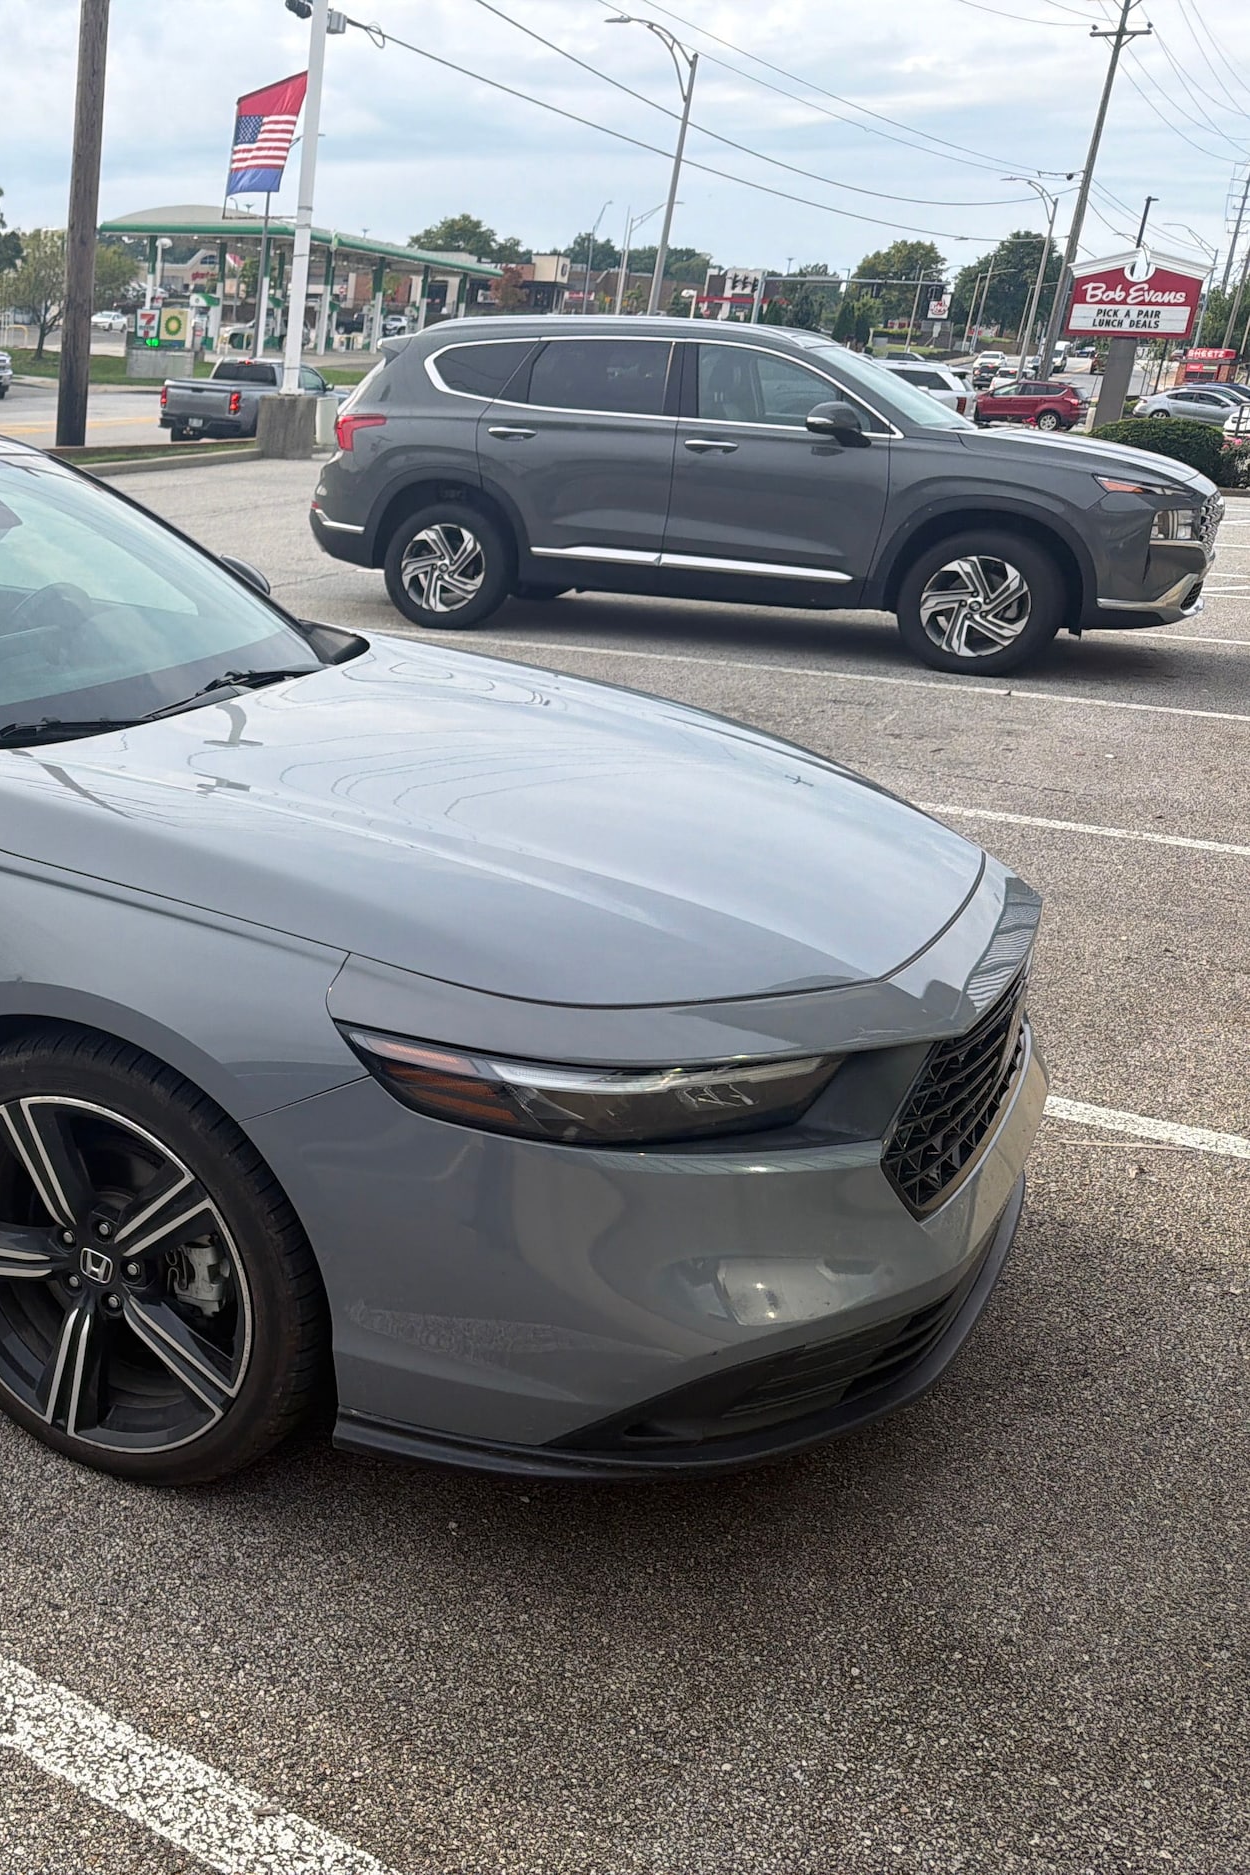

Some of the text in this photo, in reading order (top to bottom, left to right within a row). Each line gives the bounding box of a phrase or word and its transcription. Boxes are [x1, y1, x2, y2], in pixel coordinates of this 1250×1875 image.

[1081, 282, 1186, 304] Bob Evans
[1096, 308, 1161, 319] PICK A PAIR
[1092, 318, 1160, 329] LUNCH DEALS
[1188, 349, 1225, 358] SHEETZ
